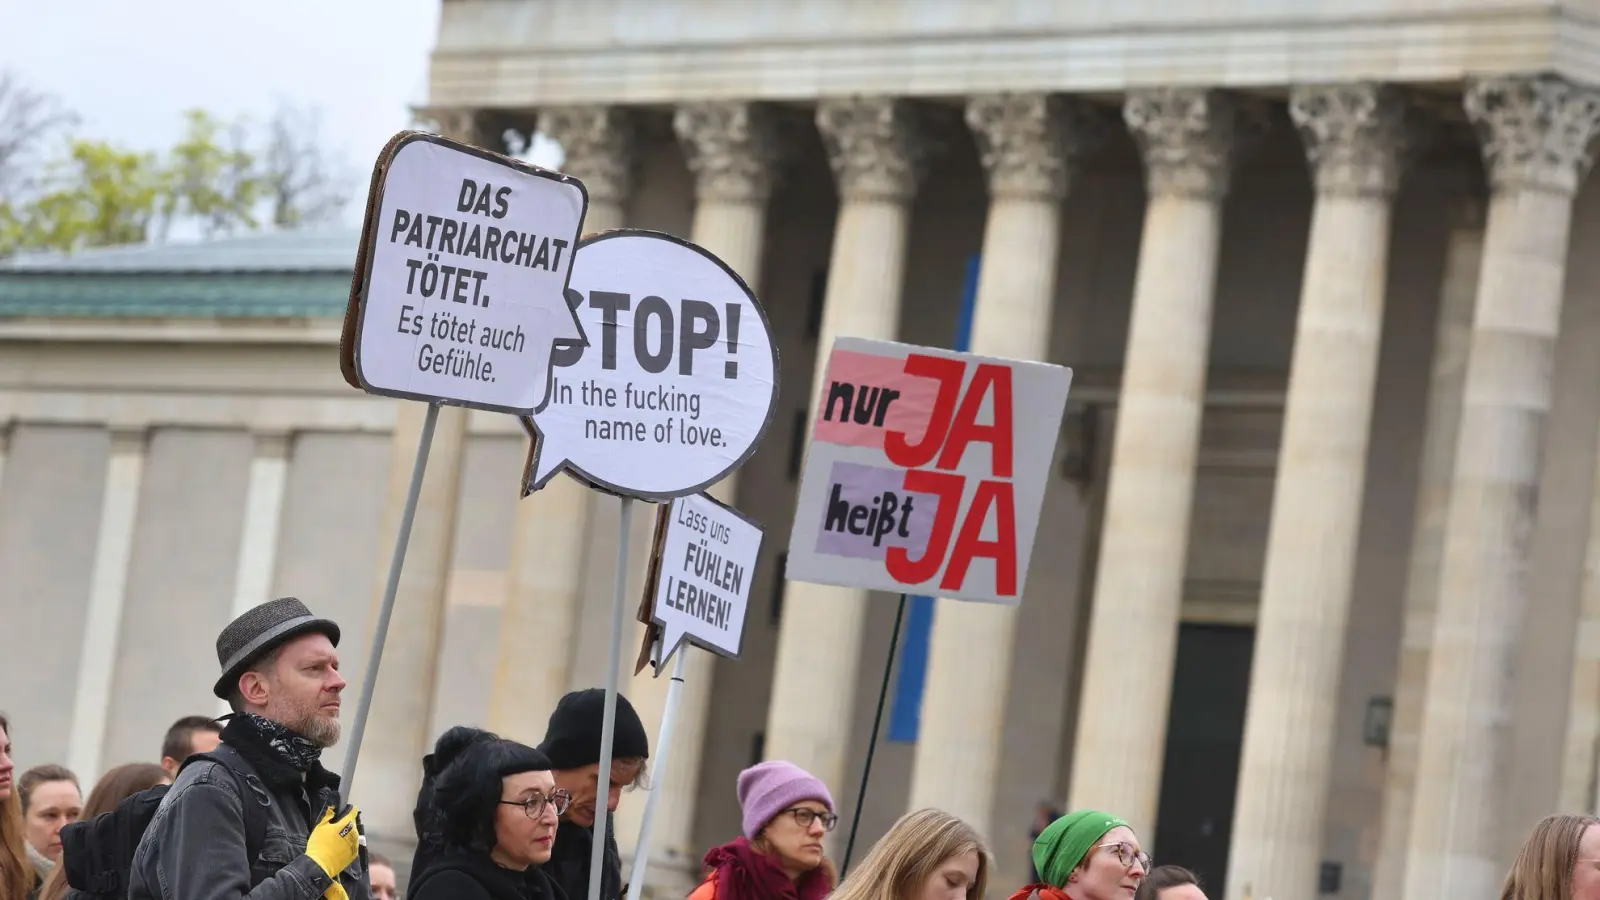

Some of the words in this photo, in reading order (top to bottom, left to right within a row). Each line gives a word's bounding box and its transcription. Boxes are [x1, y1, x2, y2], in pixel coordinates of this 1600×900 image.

[457, 178, 512, 220] DAS
[390, 208, 568, 272] PATRIARCHAT
[406, 253, 490, 308] TÖTET.
[397, 305, 423, 335] Es
[430, 312, 476, 345] tötet
[480, 325, 525, 352] auch
[418, 344, 496, 383] Gefühle.
[553, 377, 572, 404] In
[581, 380, 616, 407] the
[625, 382, 700, 420] fucking
[823, 380, 900, 427] nur
[883, 353, 1014, 478] JA
[585, 419, 646, 441] name
[654, 420, 674, 443] of
[680, 418, 727, 447] love.
[677, 500, 708, 534] Lass
[710, 520, 730, 545] uns
[824, 483, 914, 547] heißt
[884, 469, 1017, 596] JA
[684, 539, 744, 595] FÜHLEN
[665, 576, 732, 631] LERNEN!
